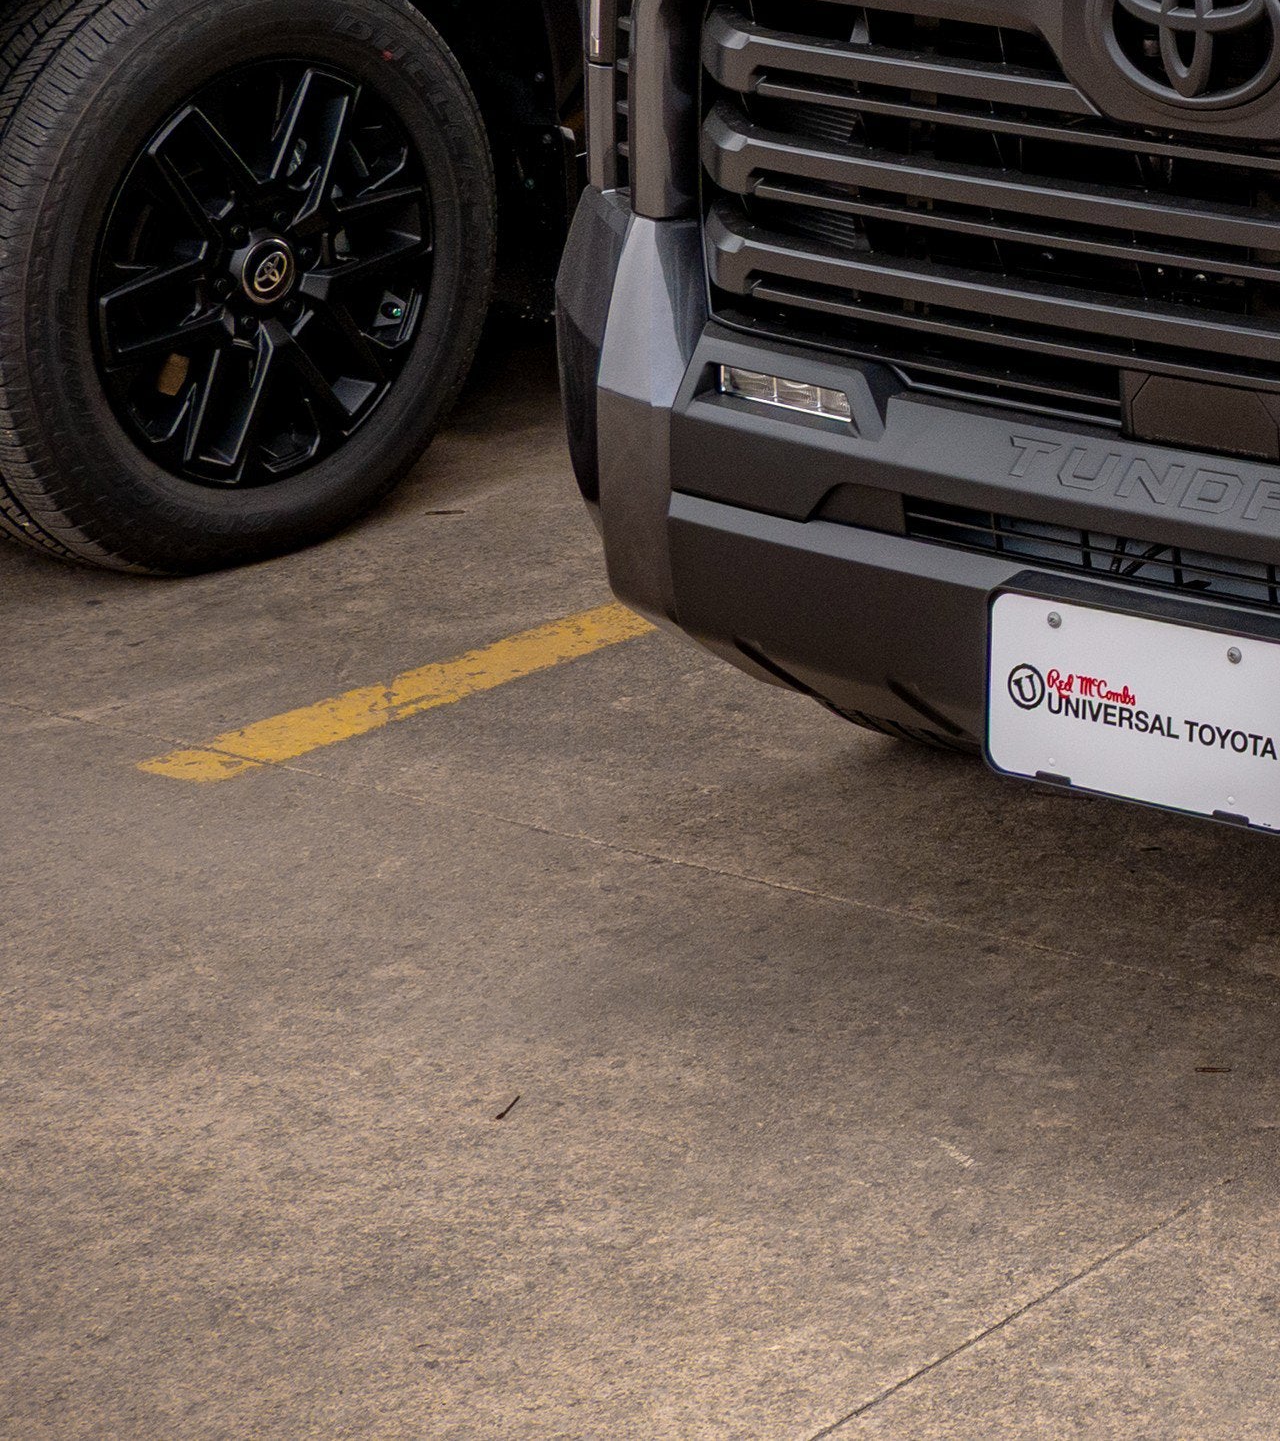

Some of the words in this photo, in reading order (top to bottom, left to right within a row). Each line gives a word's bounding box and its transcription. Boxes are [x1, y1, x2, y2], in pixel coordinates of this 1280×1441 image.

[1047, 668, 1074, 699] Red
[1076, 674, 1136, 706] McCombs
[1047, 691, 1180, 739] UNIVERSAL
[1184, 720, 1278, 761] TOYOTA
